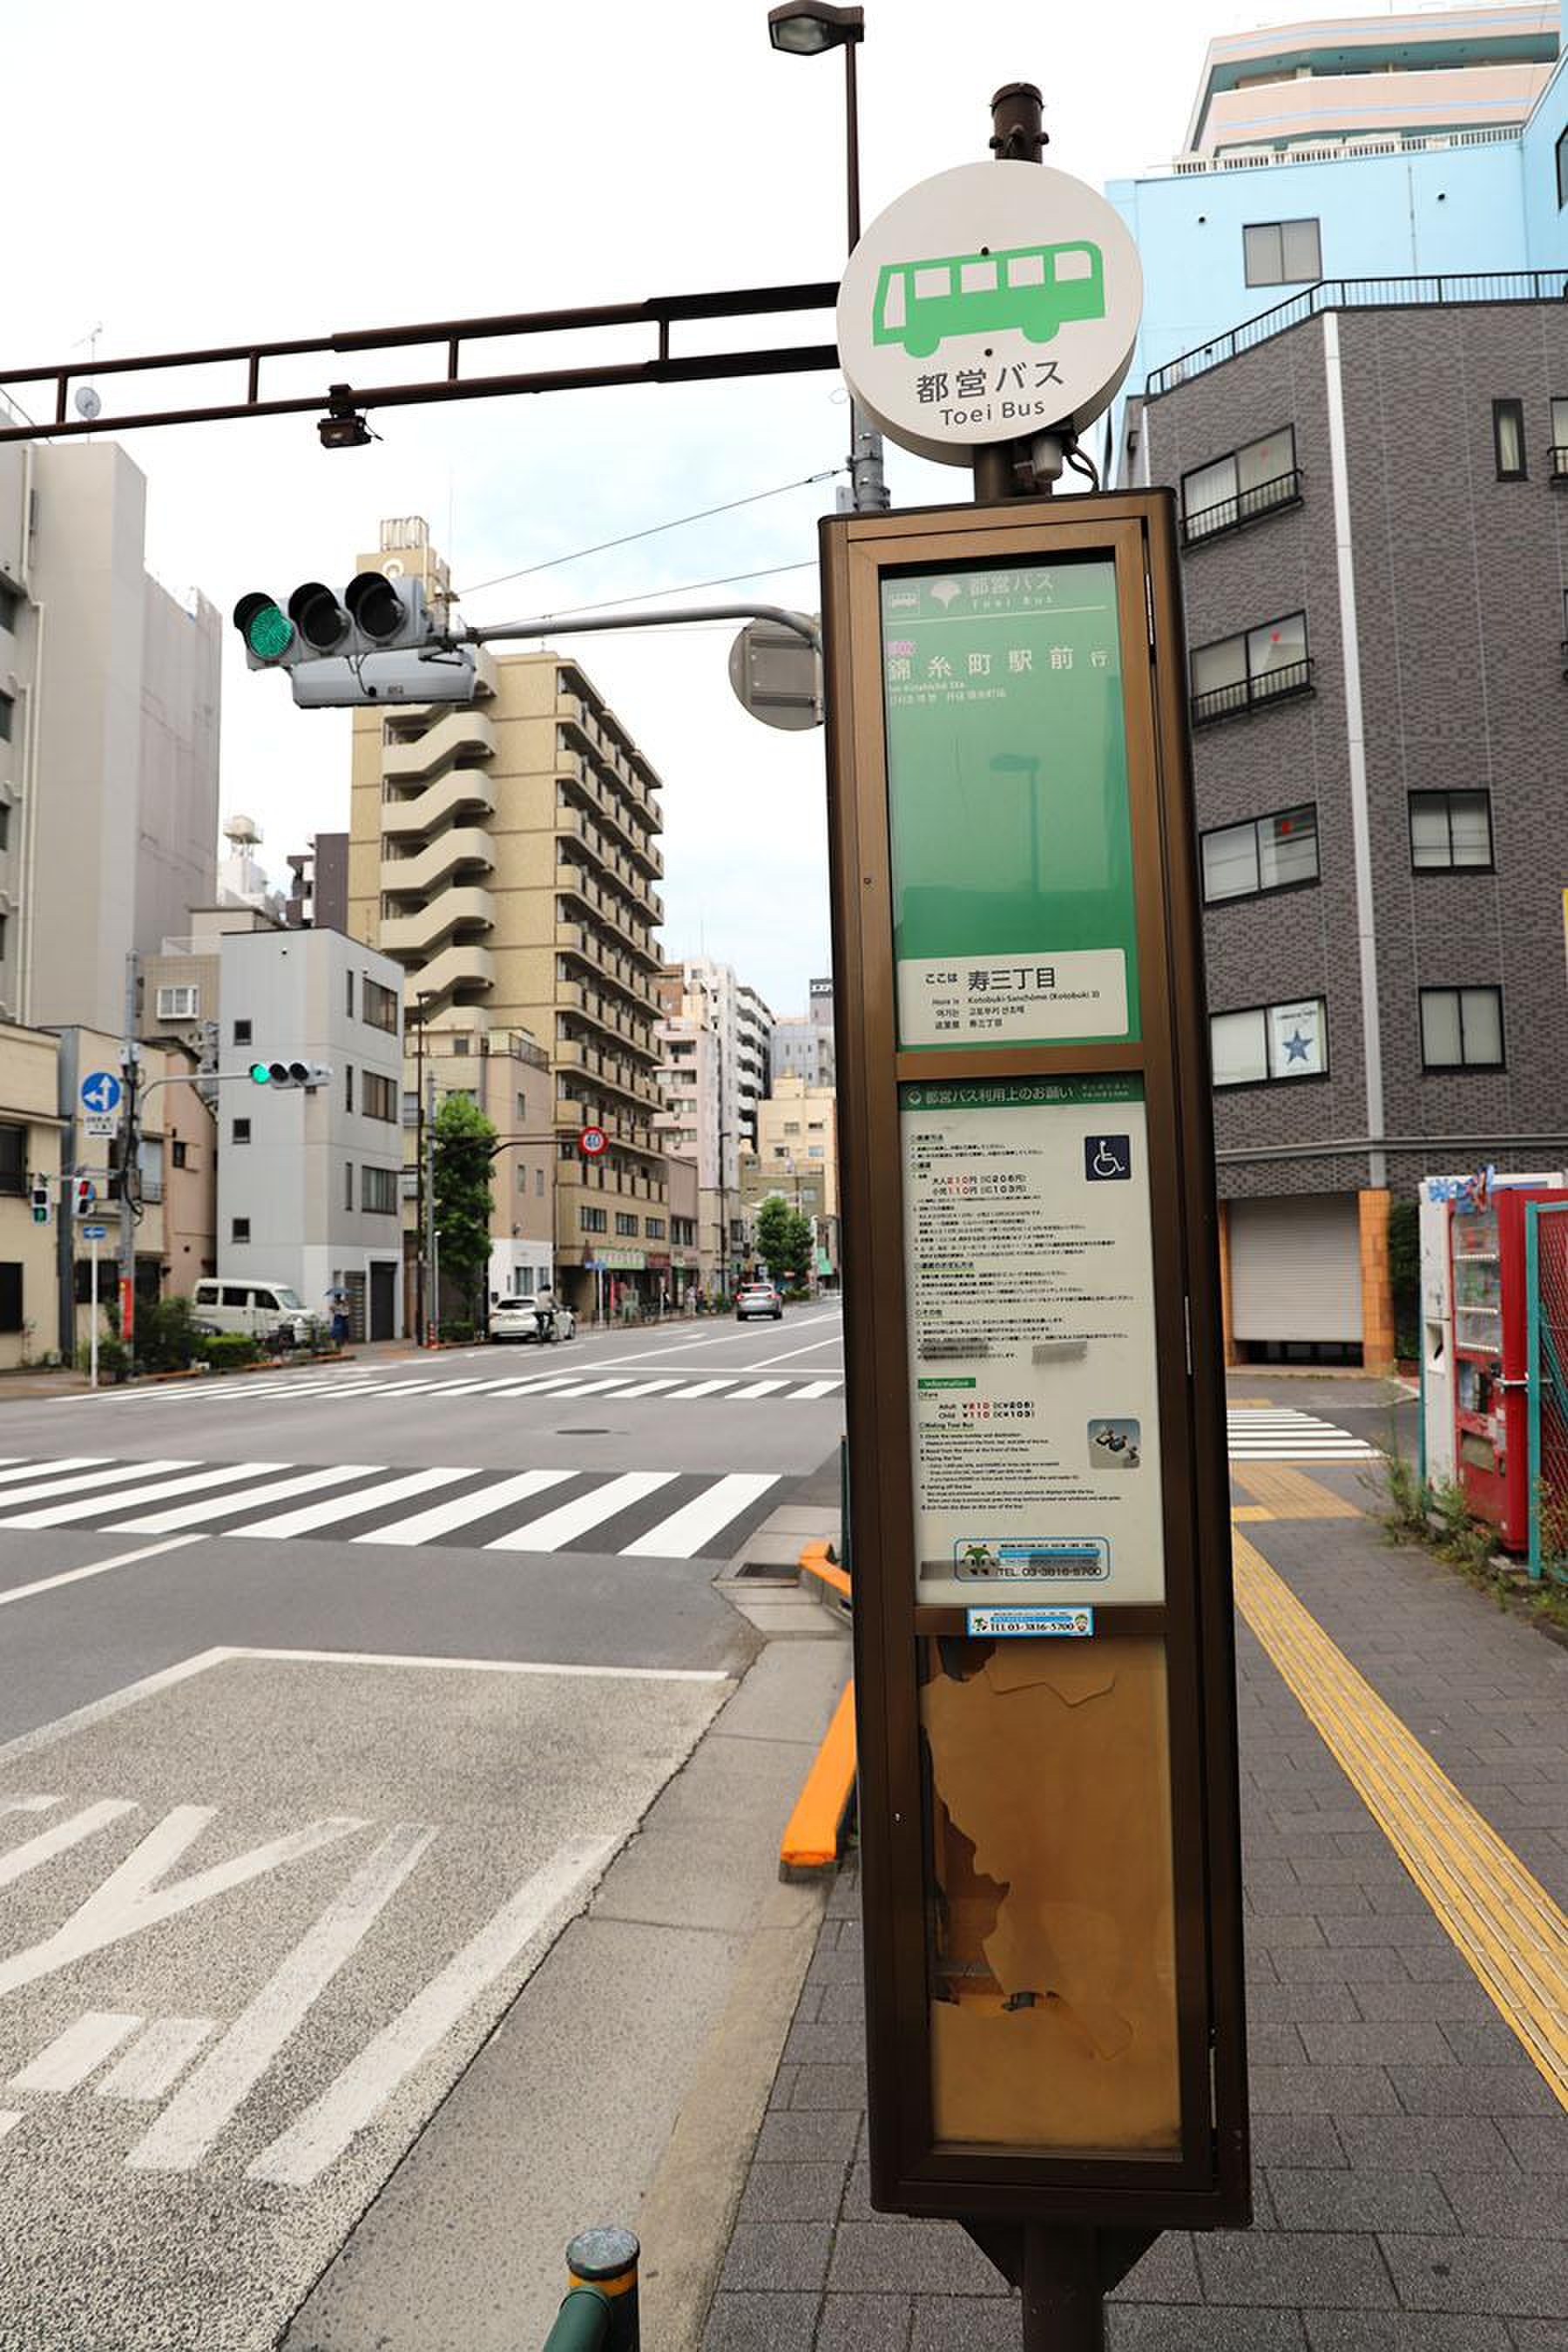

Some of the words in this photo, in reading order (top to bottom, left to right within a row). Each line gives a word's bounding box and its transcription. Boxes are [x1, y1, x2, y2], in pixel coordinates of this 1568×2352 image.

[917, 362, 1064, 403] 都営バス
[940, 403, 991, 425] Toei
[1003, 401, 1044, 418] Bus
[925, 972, 957, 984] ここは
[968, 967, 1055, 991] 寿三丁目
